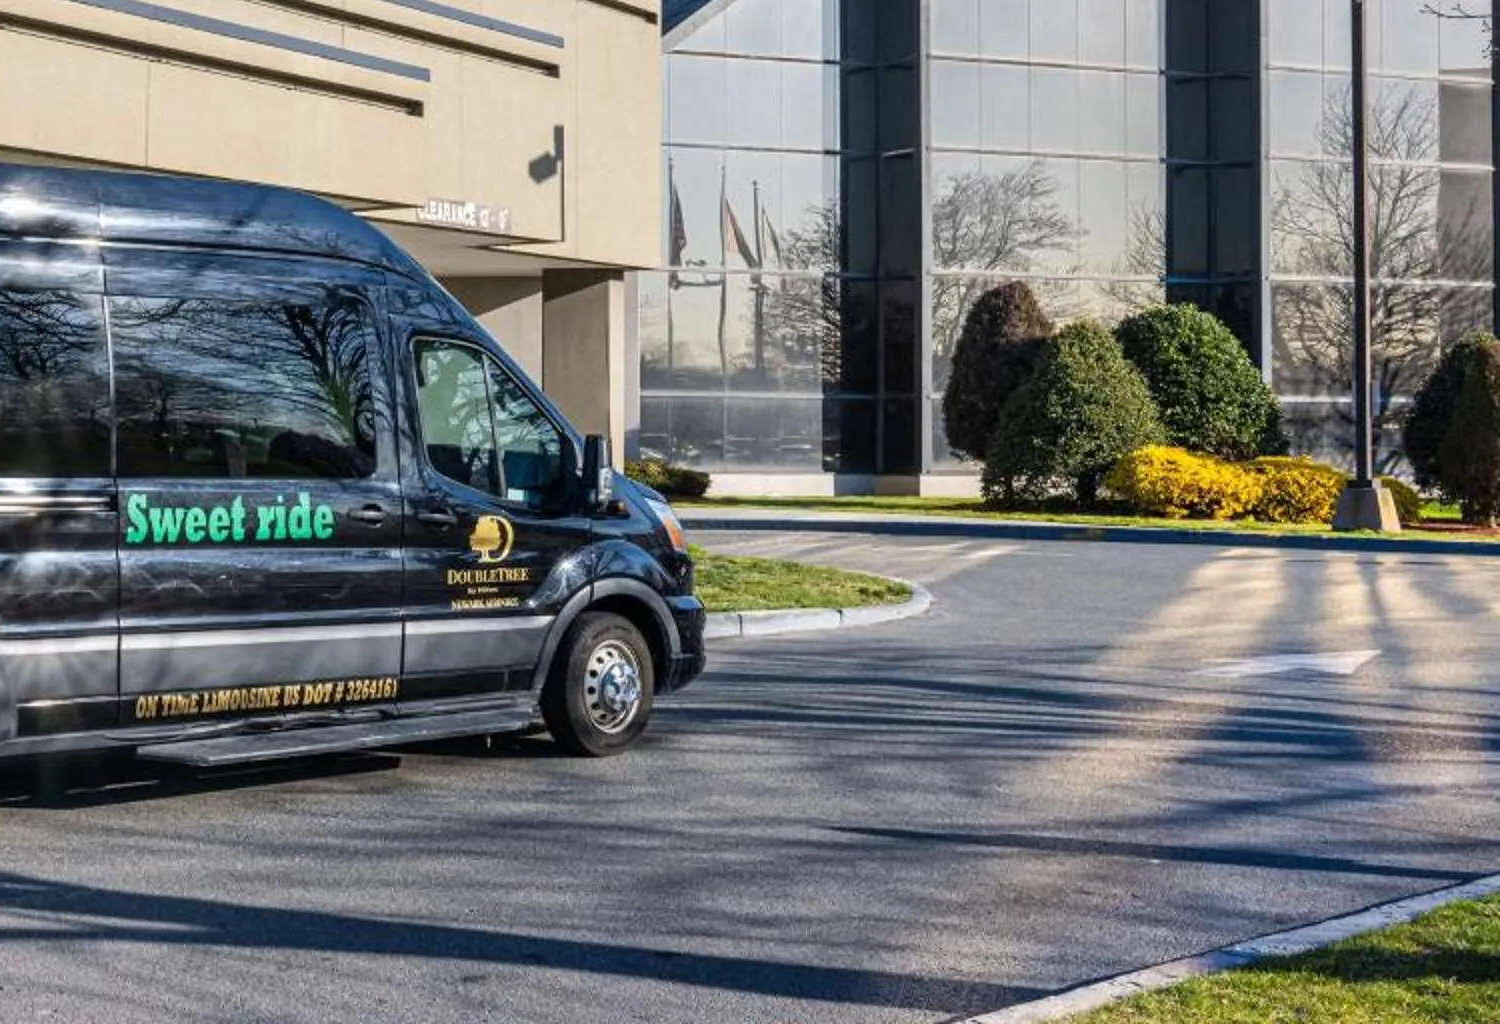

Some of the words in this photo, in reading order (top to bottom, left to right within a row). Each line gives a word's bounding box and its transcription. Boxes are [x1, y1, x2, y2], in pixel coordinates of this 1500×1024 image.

[126, 492, 246, 544] Sweet
[256, 490, 335, 541] ride
[446, 567, 530, 585] DOUBLETREE
[135, 695, 159, 718] ON
[161, 693, 199, 717] TIME
[202, 684, 281, 713] LIMOUSINE
[283, 684, 301, 707] US
[302, 681, 334, 706] DOT
[334, 679, 345, 703] #
